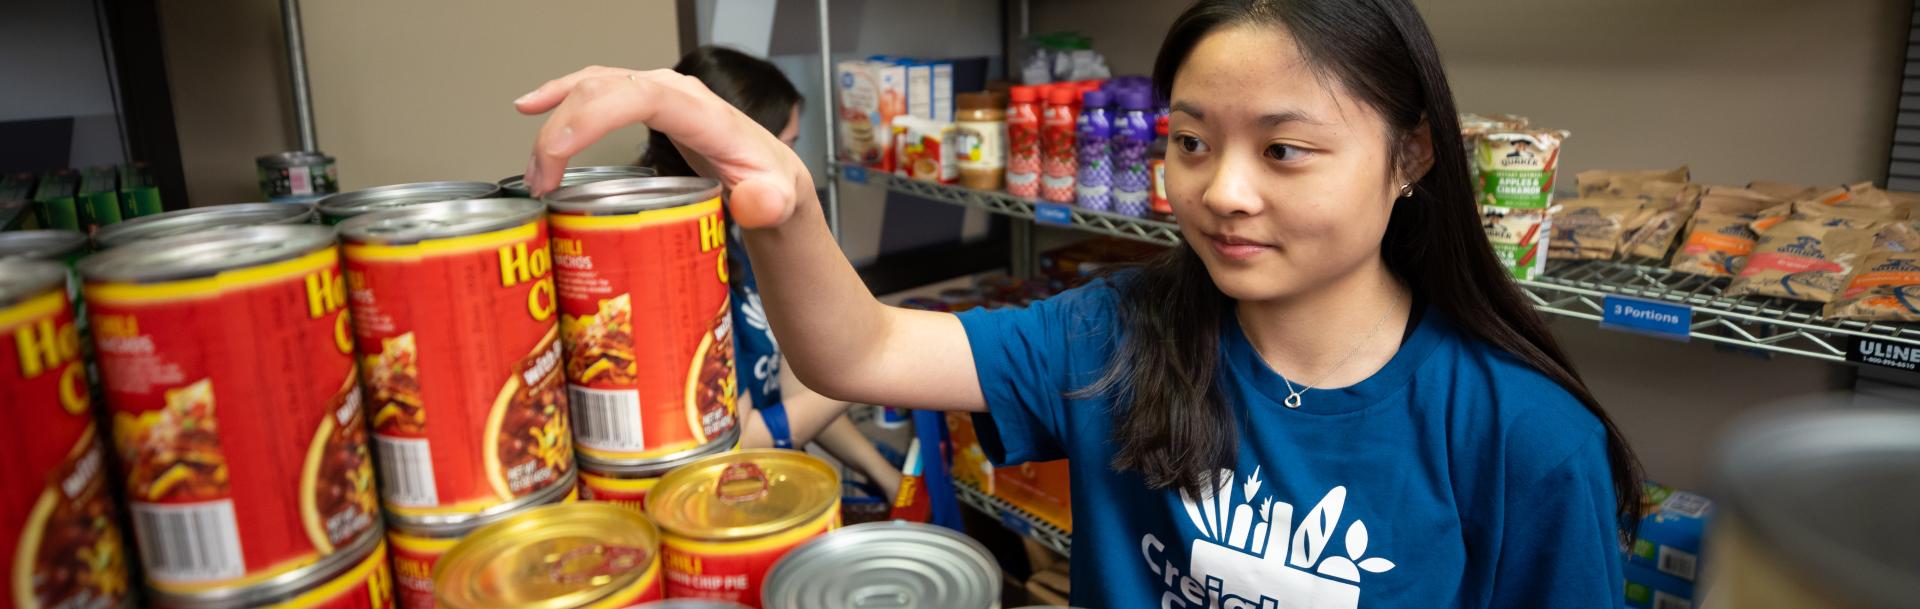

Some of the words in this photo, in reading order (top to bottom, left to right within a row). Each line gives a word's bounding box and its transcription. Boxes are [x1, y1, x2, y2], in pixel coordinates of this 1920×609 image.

[1499, 178, 1531, 187] APPLES
[1614, 304, 1623, 316] 3
[1624, 305, 1680, 325] Portions
[1860, 340, 1920, 363] ULINE
